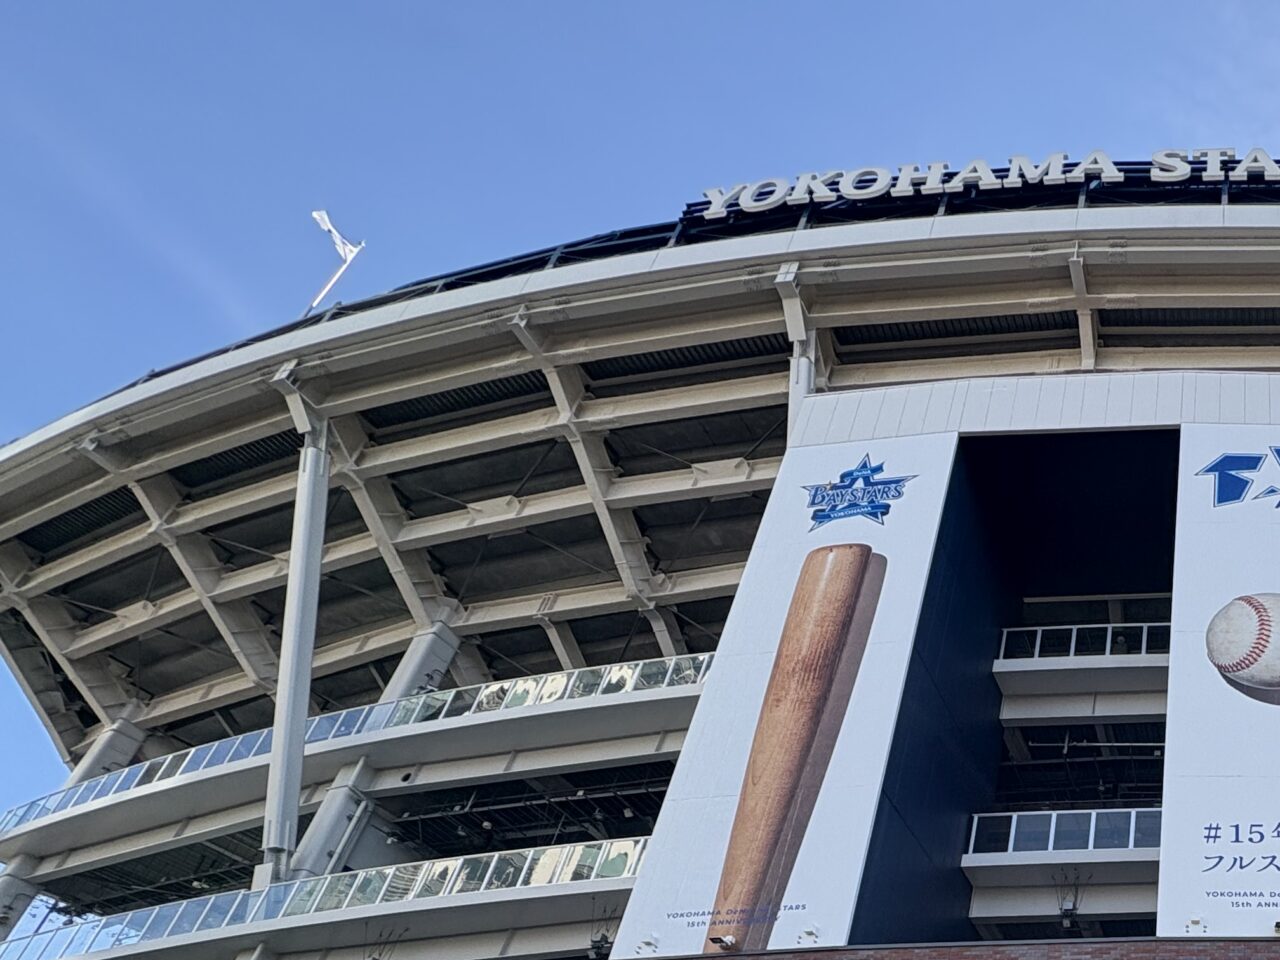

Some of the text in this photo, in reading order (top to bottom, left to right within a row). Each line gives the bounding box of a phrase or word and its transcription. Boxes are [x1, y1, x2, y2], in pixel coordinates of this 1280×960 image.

[702, 149, 1124, 219] YOKOHAMA
[807, 482, 905, 508] BAYSTARS
[1205, 891, 1265, 899] YOKOHAMA
[666, 910, 721, 919] YOKOHAMA
[687, 920, 707, 928] 15th
